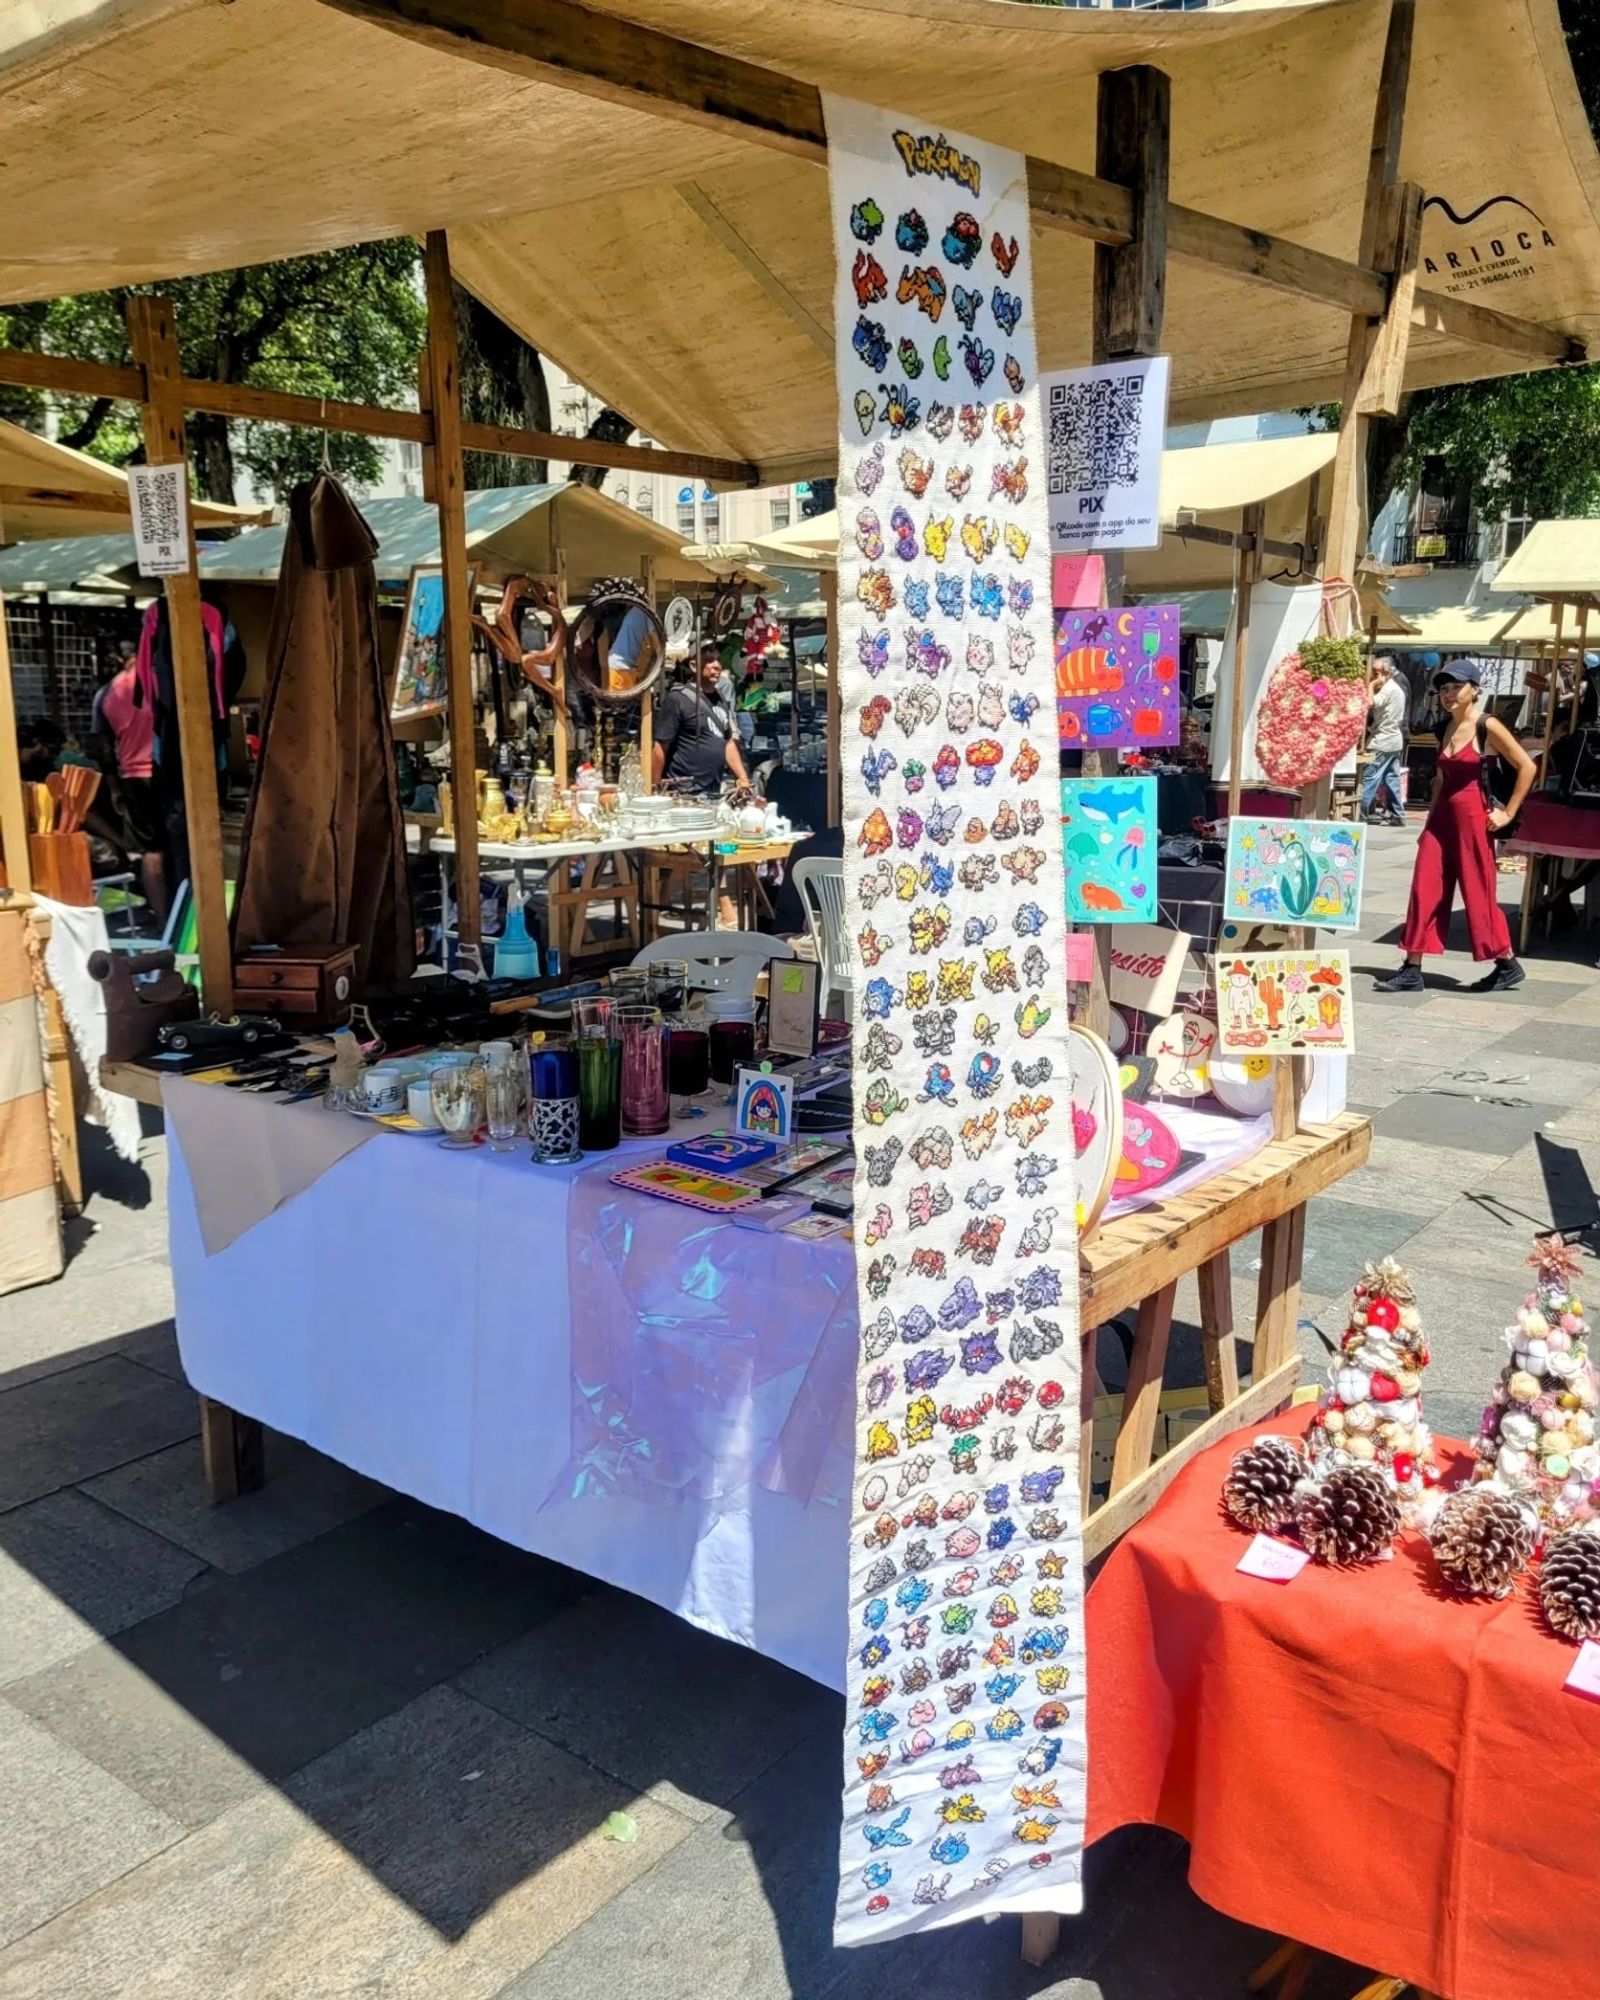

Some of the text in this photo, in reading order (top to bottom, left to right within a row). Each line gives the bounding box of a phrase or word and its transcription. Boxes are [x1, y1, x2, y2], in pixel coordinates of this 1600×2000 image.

[1424, 230, 1556, 274] ARIOCA
[1452, 257, 1520, 279] FEIRAS E EVENTOS
[1467, 279, 1480, 289] 21
[1481, 265, 1535, 285] 96404-1181
[1079, 496, 1105, 514] PIX
[1108, 519, 1124, 528] app
[1125, 516, 1136, 526] do
[1136, 517, 1151, 525] seu
[1058, 528, 1125, 539] banco para pagar
